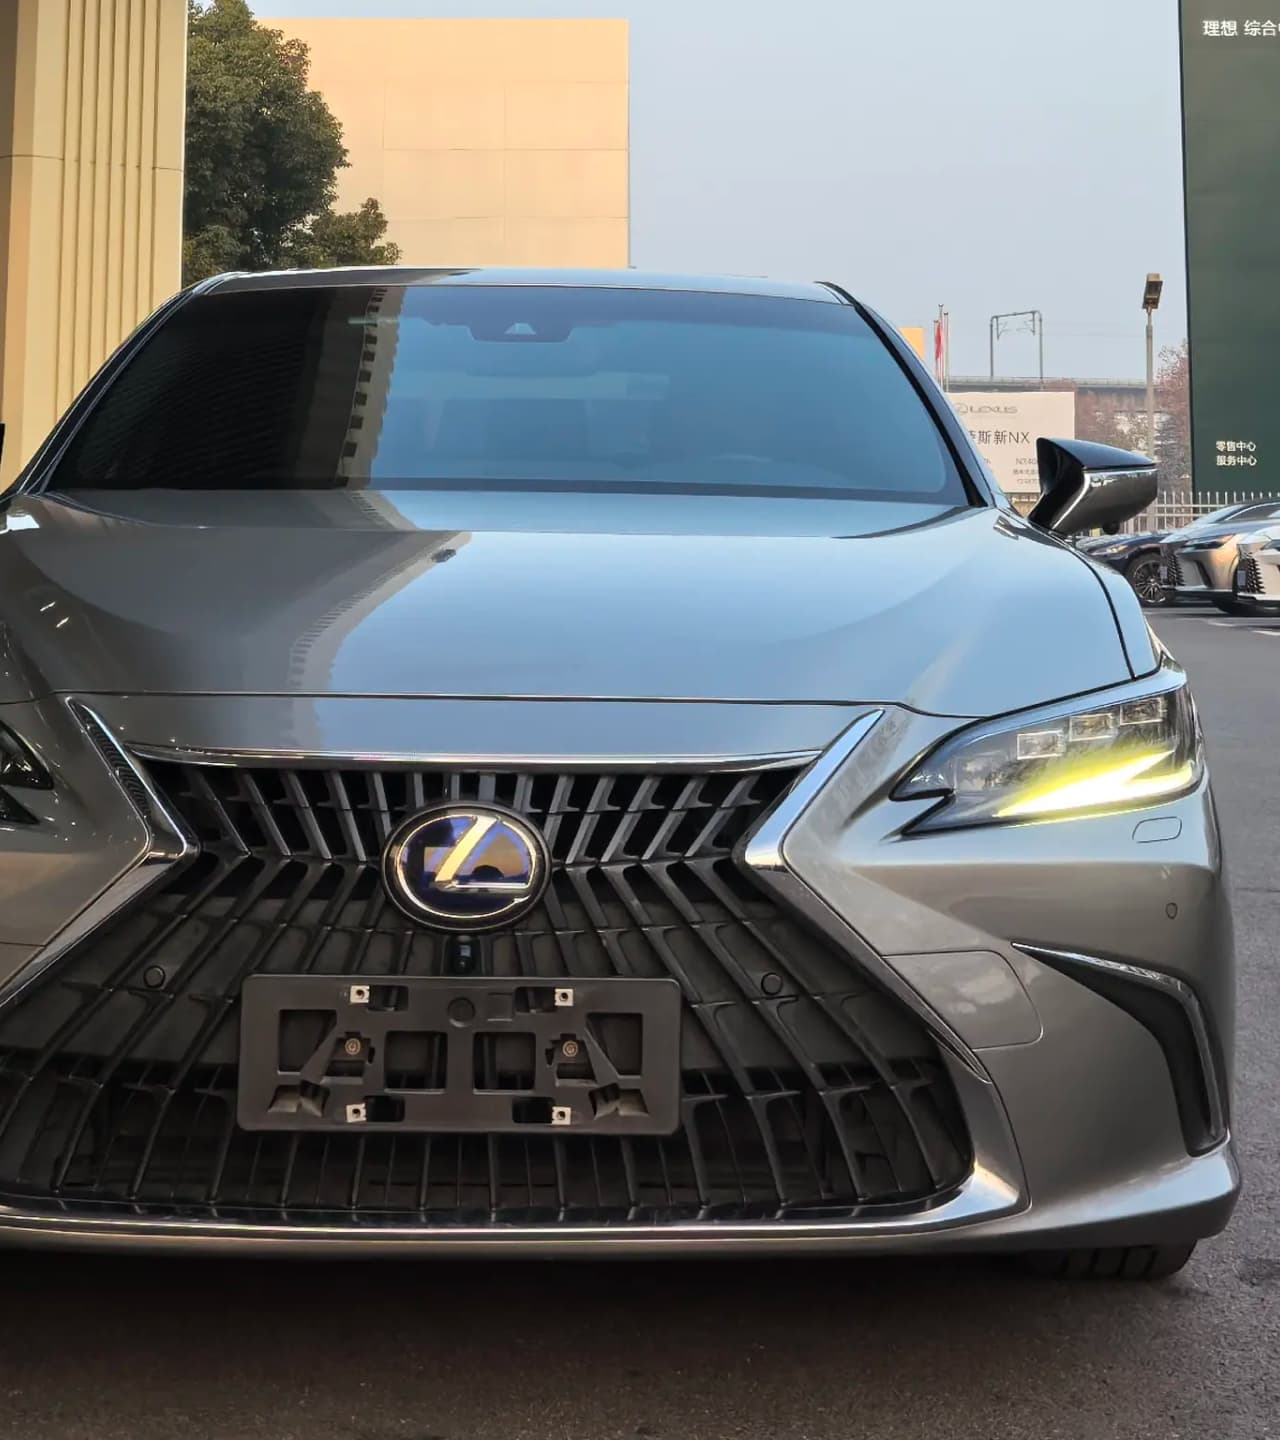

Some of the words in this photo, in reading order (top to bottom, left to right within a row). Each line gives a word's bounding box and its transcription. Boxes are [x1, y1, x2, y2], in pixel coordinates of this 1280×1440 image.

[1202, 19, 1238, 37] 理想
[1216, 455, 1258, 467] 服务中心
